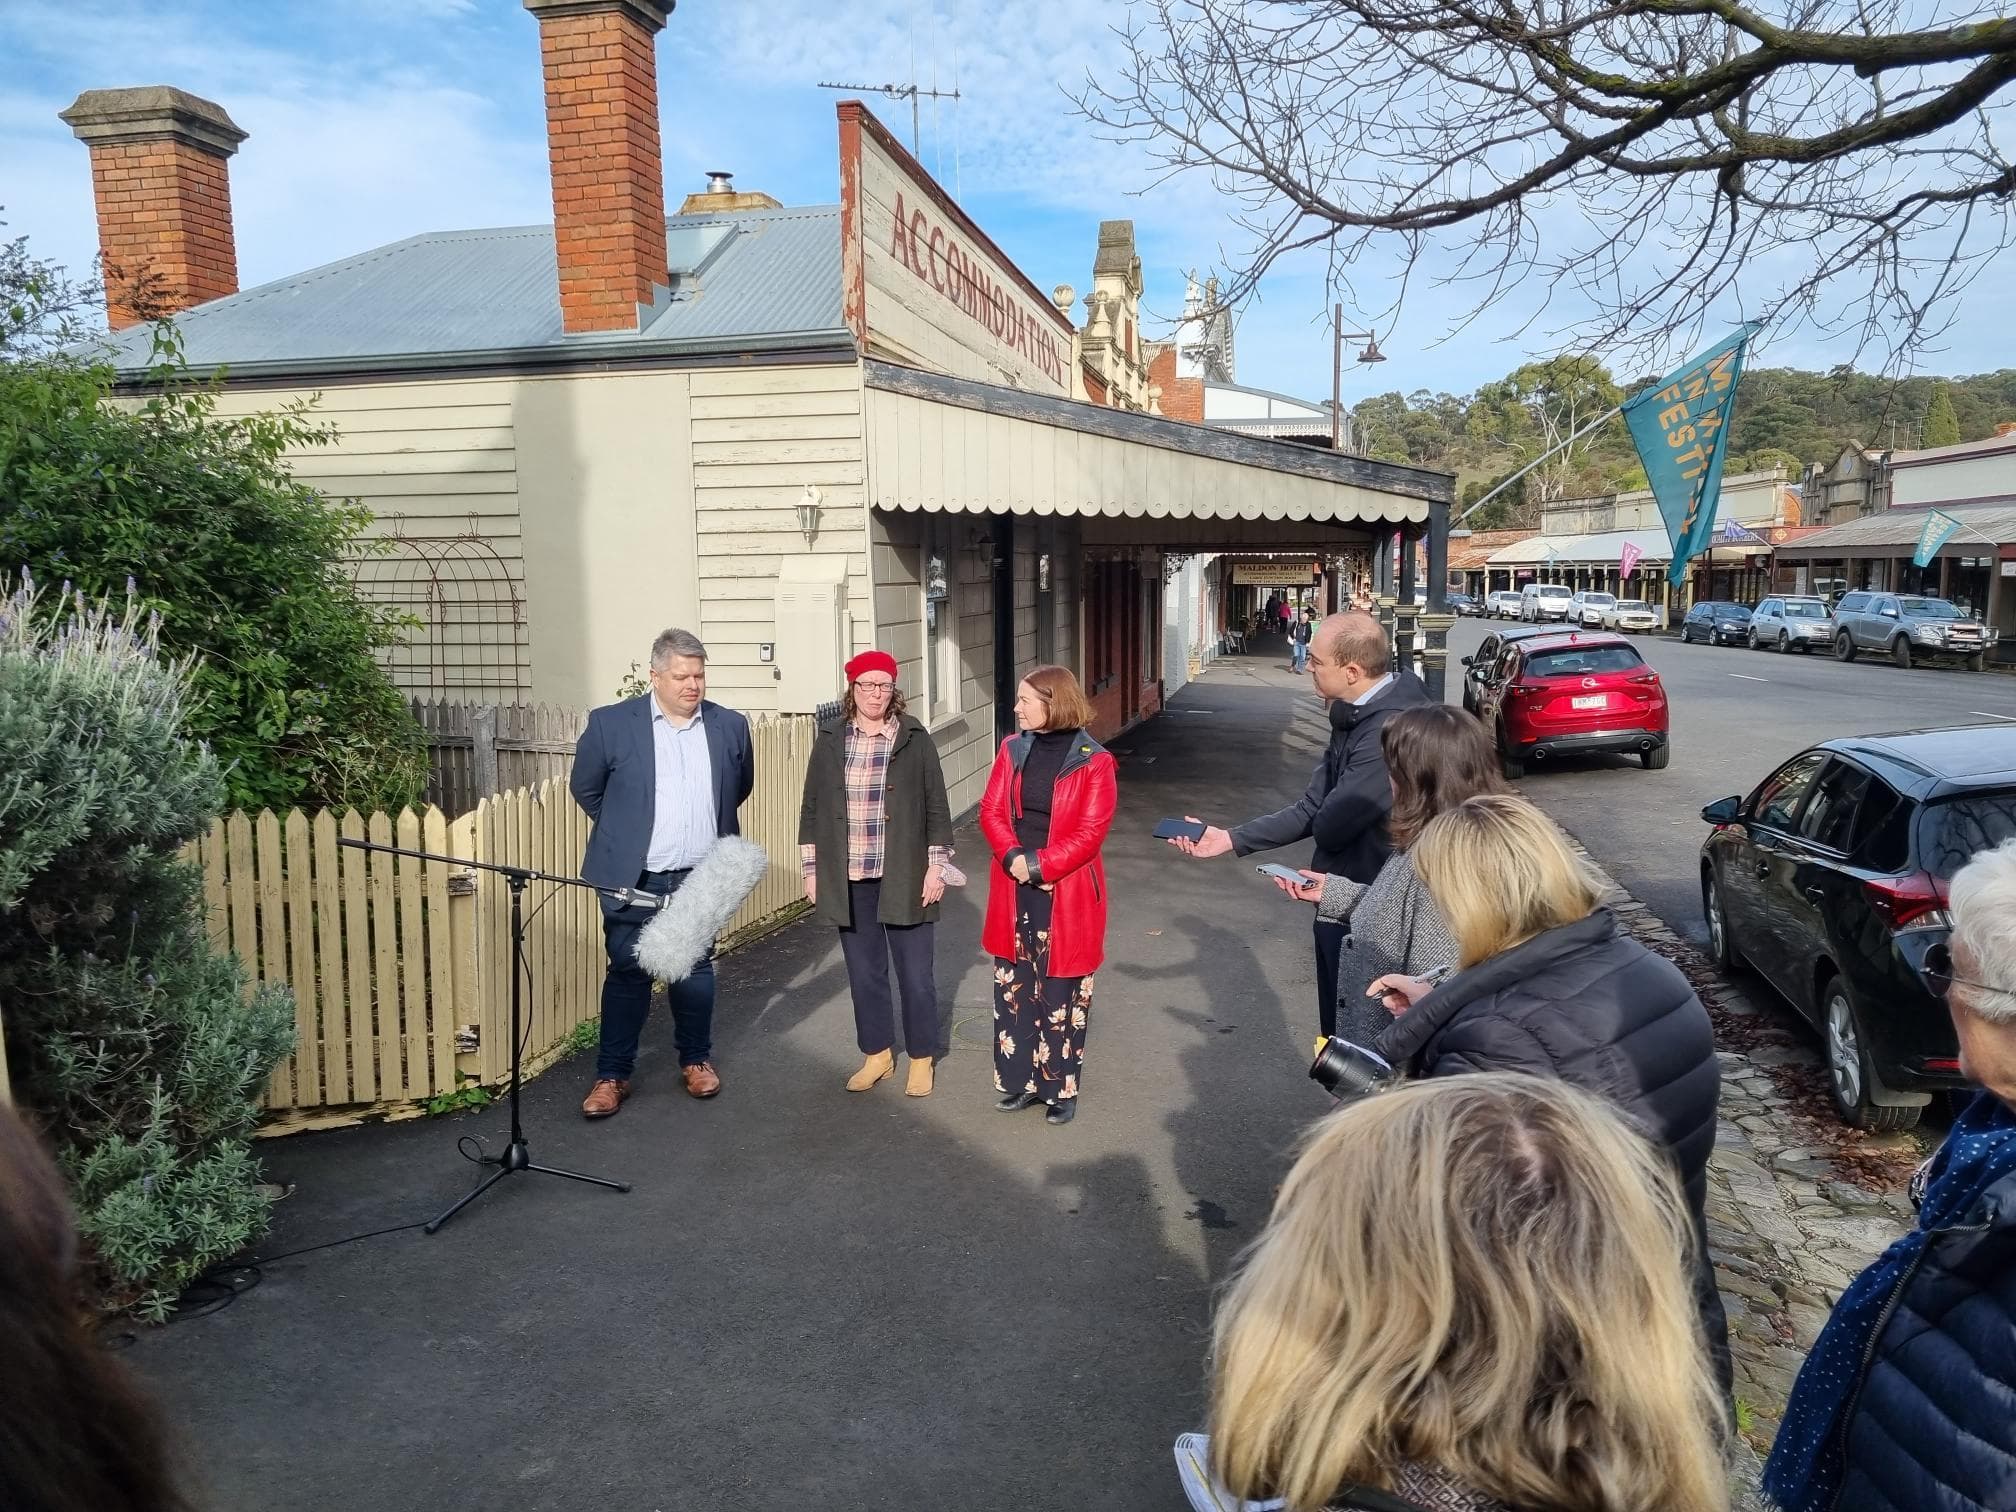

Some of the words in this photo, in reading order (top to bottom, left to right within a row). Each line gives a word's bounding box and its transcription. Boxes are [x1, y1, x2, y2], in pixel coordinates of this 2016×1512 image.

[891, 191, 1063, 386] ACCOMMODATION
[1653, 384, 1707, 480] FESTI
[1238, 564, 1277, 572] MALDON
[1280, 564, 1310, 572] HOTEL
